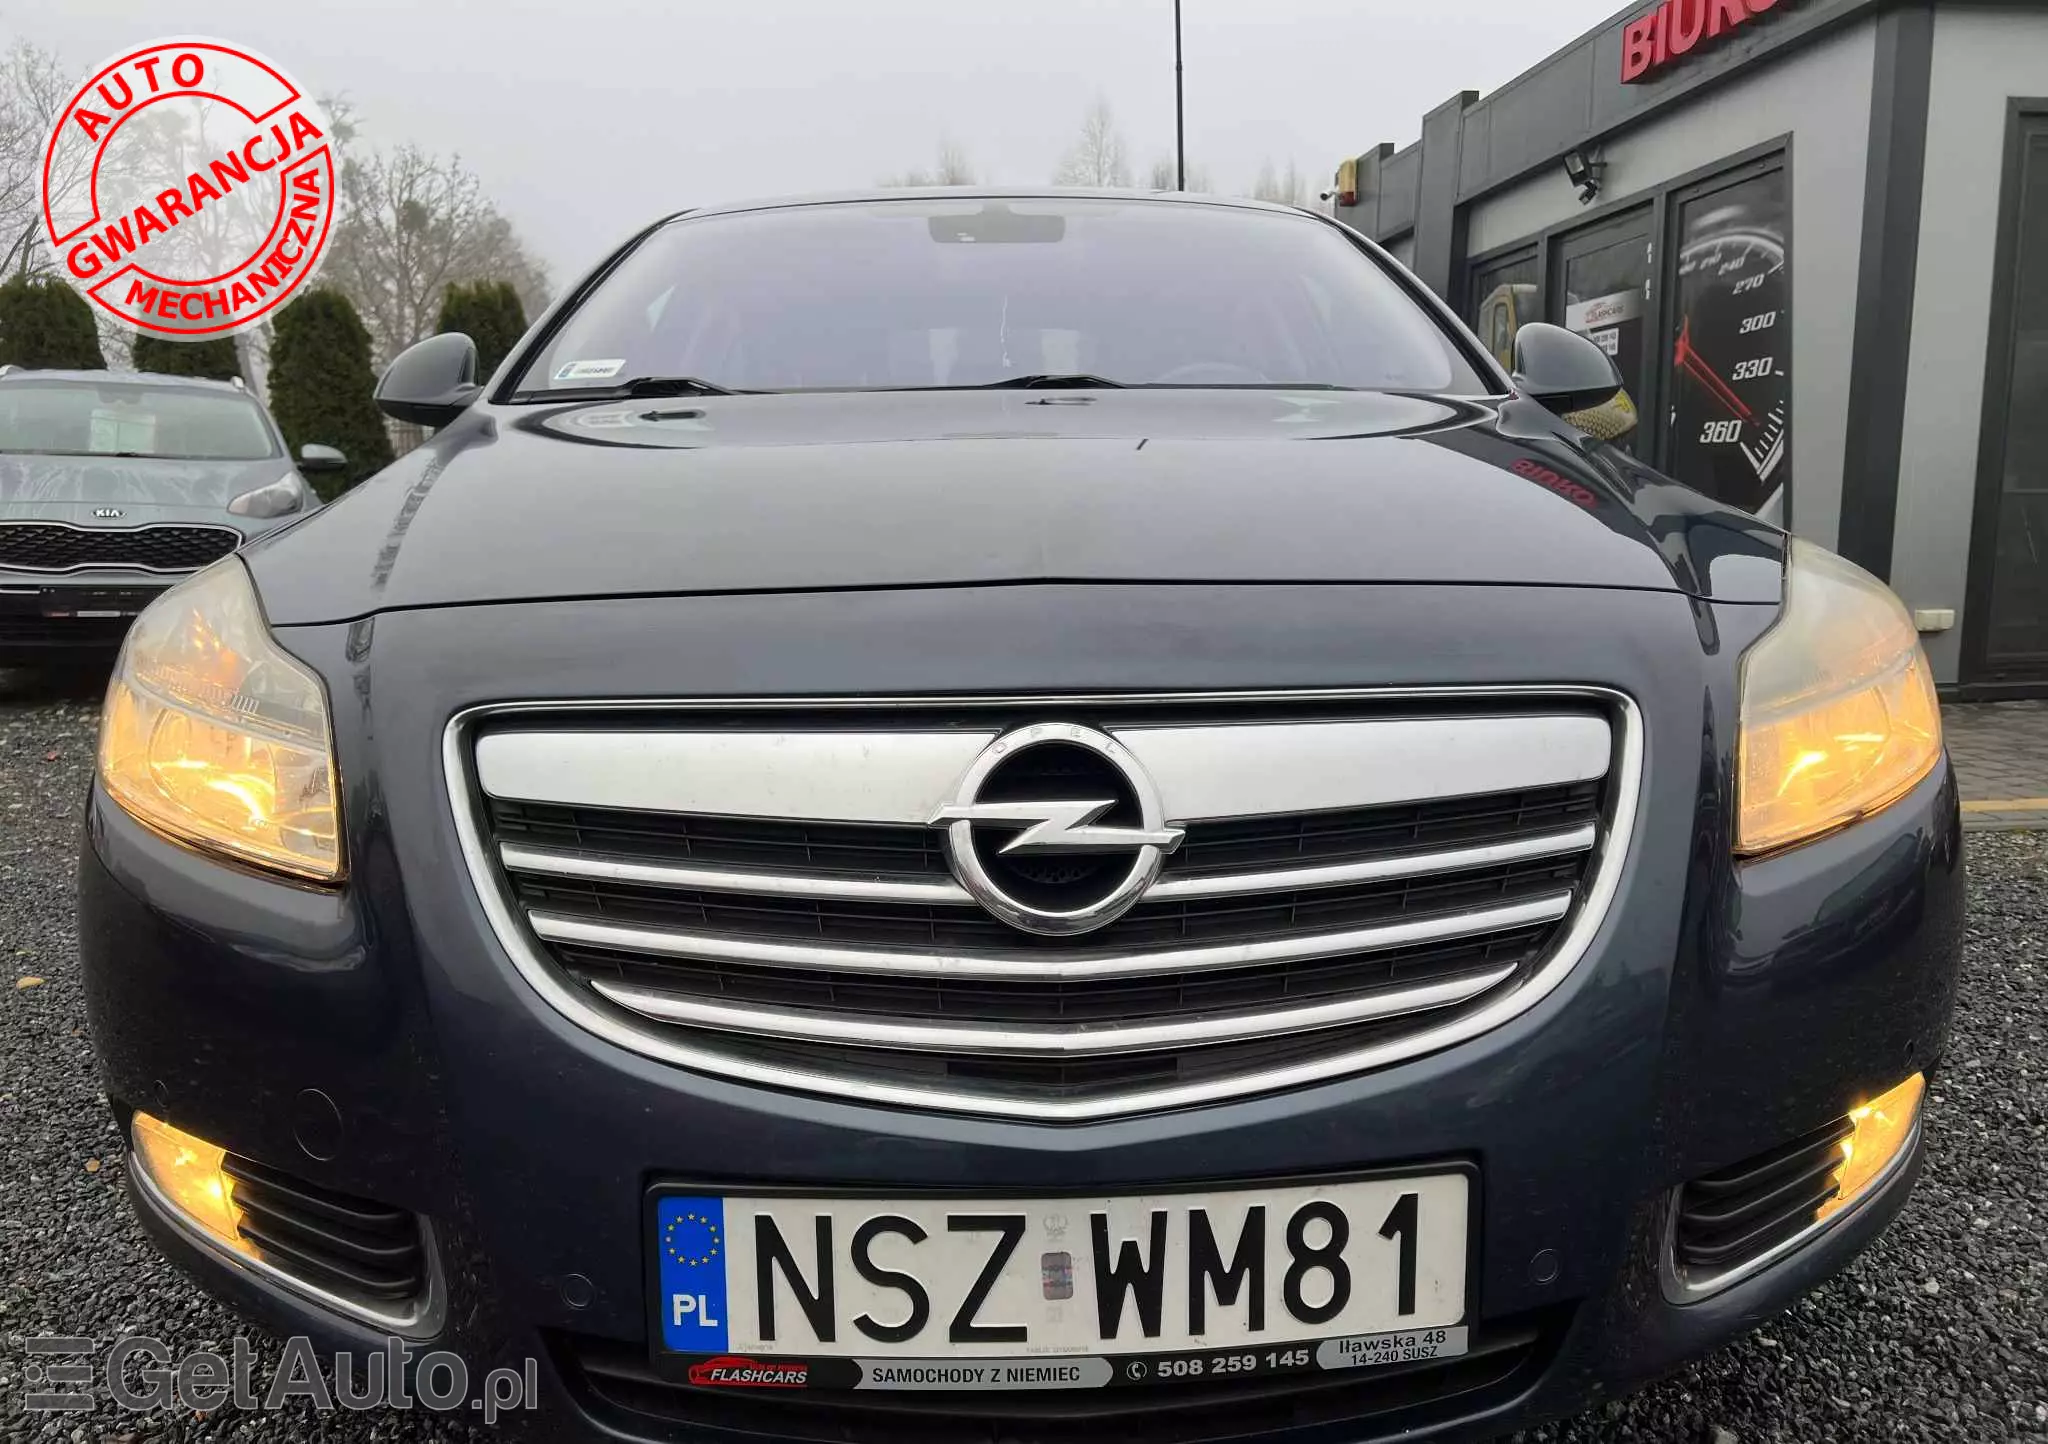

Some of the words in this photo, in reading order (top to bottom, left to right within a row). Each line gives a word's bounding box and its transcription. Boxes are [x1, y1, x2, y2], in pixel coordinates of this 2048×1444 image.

[1732, 273, 1765, 295] 270
[1739, 311, 1776, 334] 300
[1732, 357, 1773, 380] 330
[1700, 419, 1742, 443] 360
[96, 509, 120, 517] KIA
[754, 1214, 1028, 1343] NSZ
[1090, 1193, 1419, 1339] WM81
[672, 1294, 719, 1327] PL
[1422, 1330, 1446, 1345] 48
[1157, 1360, 1204, 1378] 508
[1211, 1355, 1257, 1374] 259
[1265, 1349, 1310, 1369] 145
[1351, 1350, 1399, 1366] 14-240
[1402, 1345, 1438, 1361] SUSZ
[711, 1368, 808, 1384] FLASHCARS
[872, 1367, 985, 1383] SAMOCHODY
[990, 1369, 1001, 1383] Z
[1007, 1366, 1081, 1382] NIEMIEC
